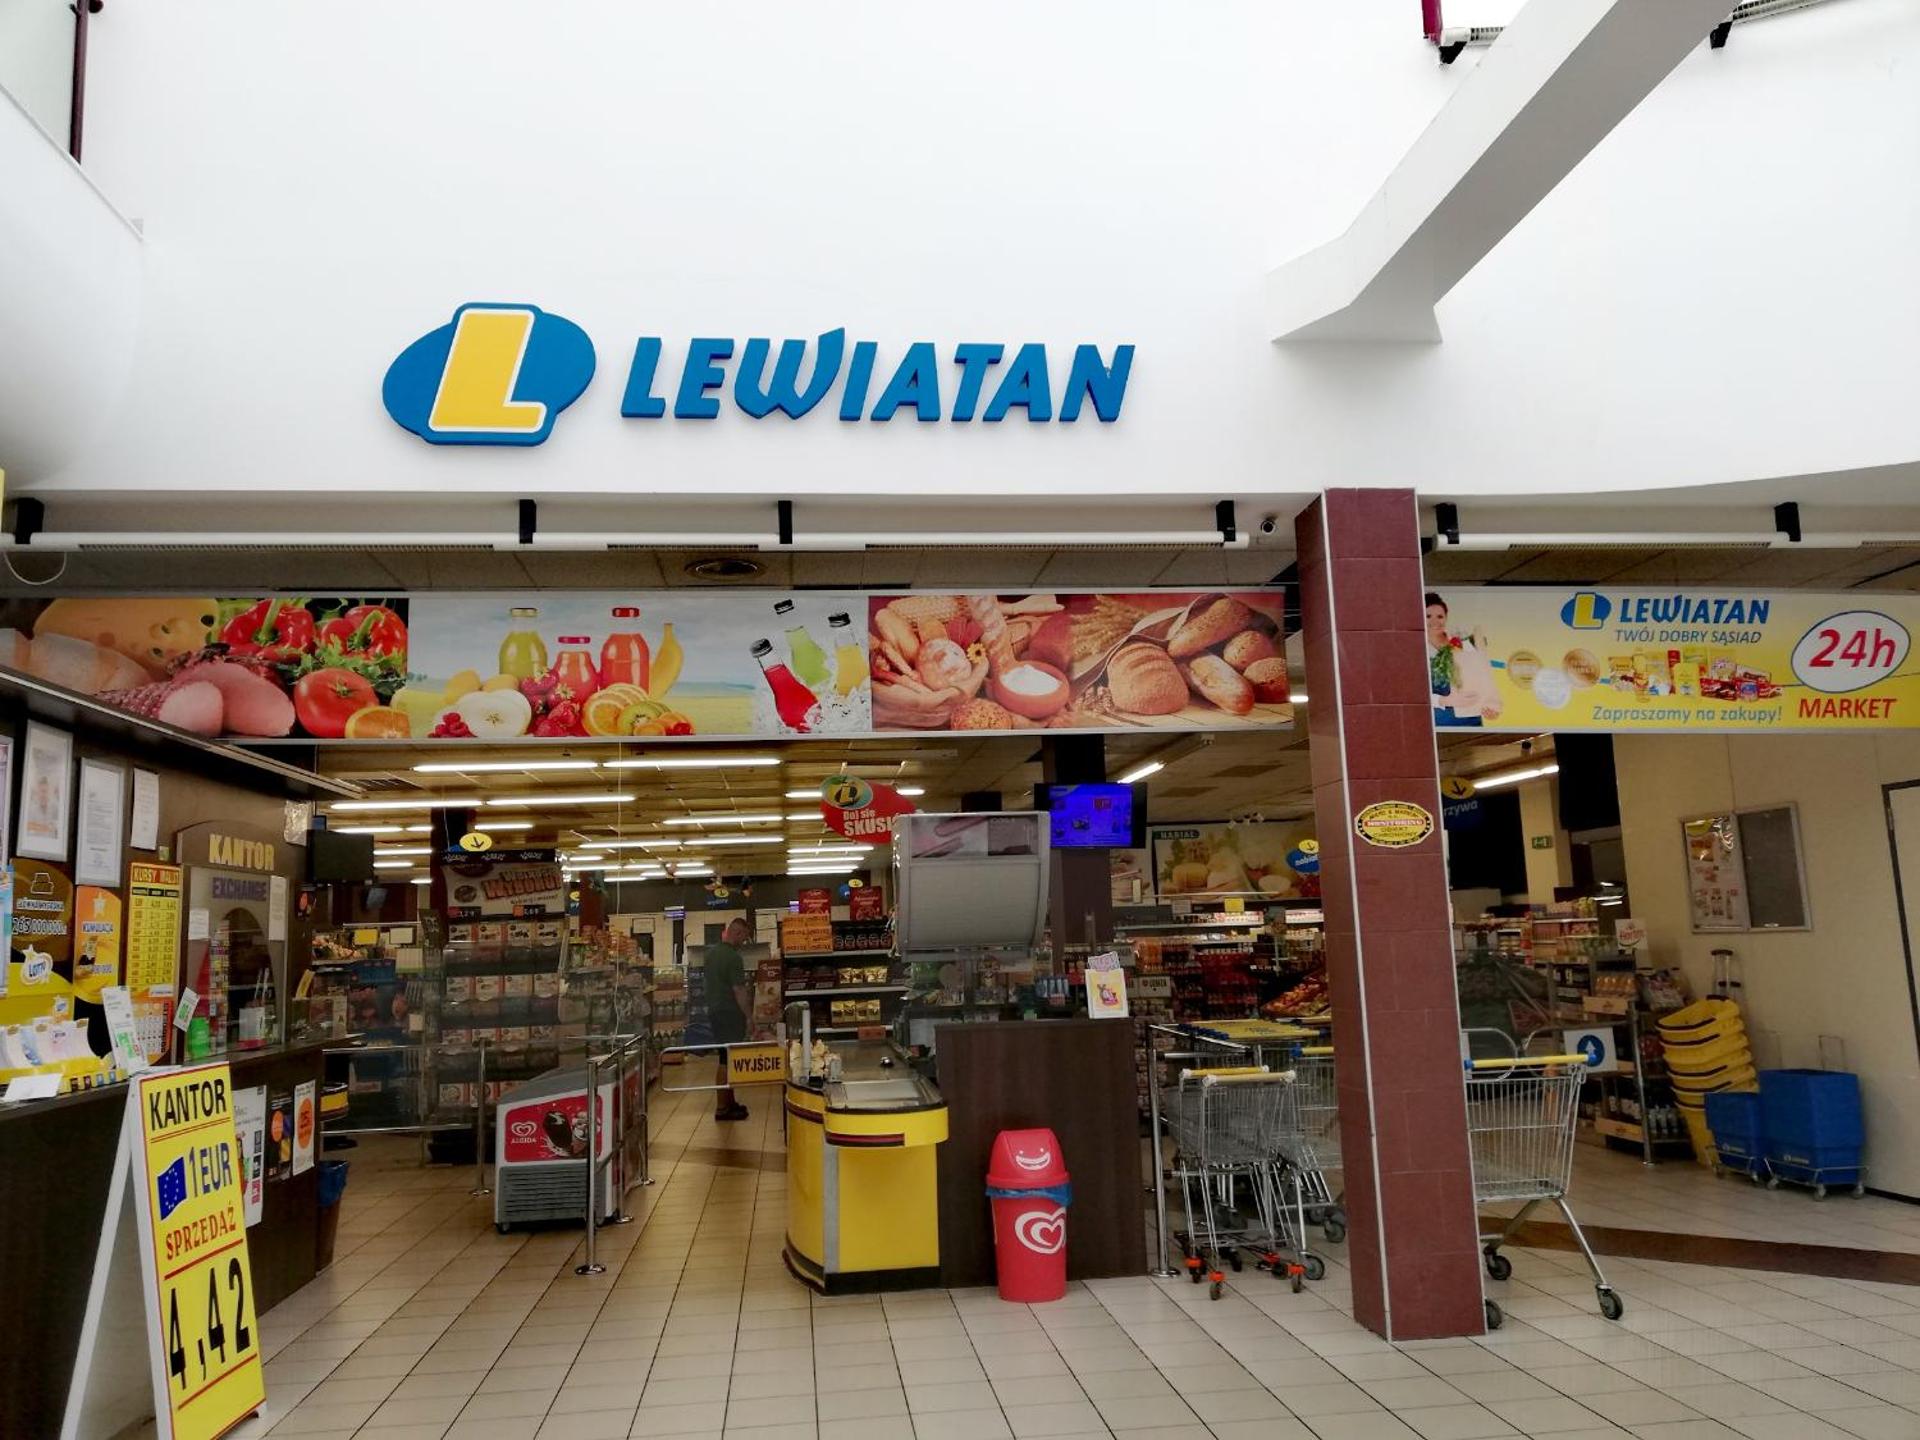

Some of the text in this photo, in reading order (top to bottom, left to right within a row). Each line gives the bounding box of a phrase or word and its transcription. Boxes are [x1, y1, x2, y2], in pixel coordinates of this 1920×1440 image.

[619, 327, 1136, 422] LEWIATAN
[1620, 594, 1770, 624] LEWIATAN
[1615, 627, 1763, 646] TWÓJ DOBRY SĄSIAD
[1809, 627, 1897, 669] 24h
[1592, 704, 1782, 725] Zapraszamy na zakupy!
[1798, 697, 1897, 719] MARKET
[844, 817, 896, 836] SKUSI
[208, 833, 275, 871] KANTOR
[212, 877, 267, 901] EXCHANGE
[733, 1054, 781, 1073] WYJŚCIE
[149, 1078, 227, 1132] KANTOR
[165, 1201, 237, 1261] SPRZEDAŻ
[169, 1257, 251, 1391] 4,42
